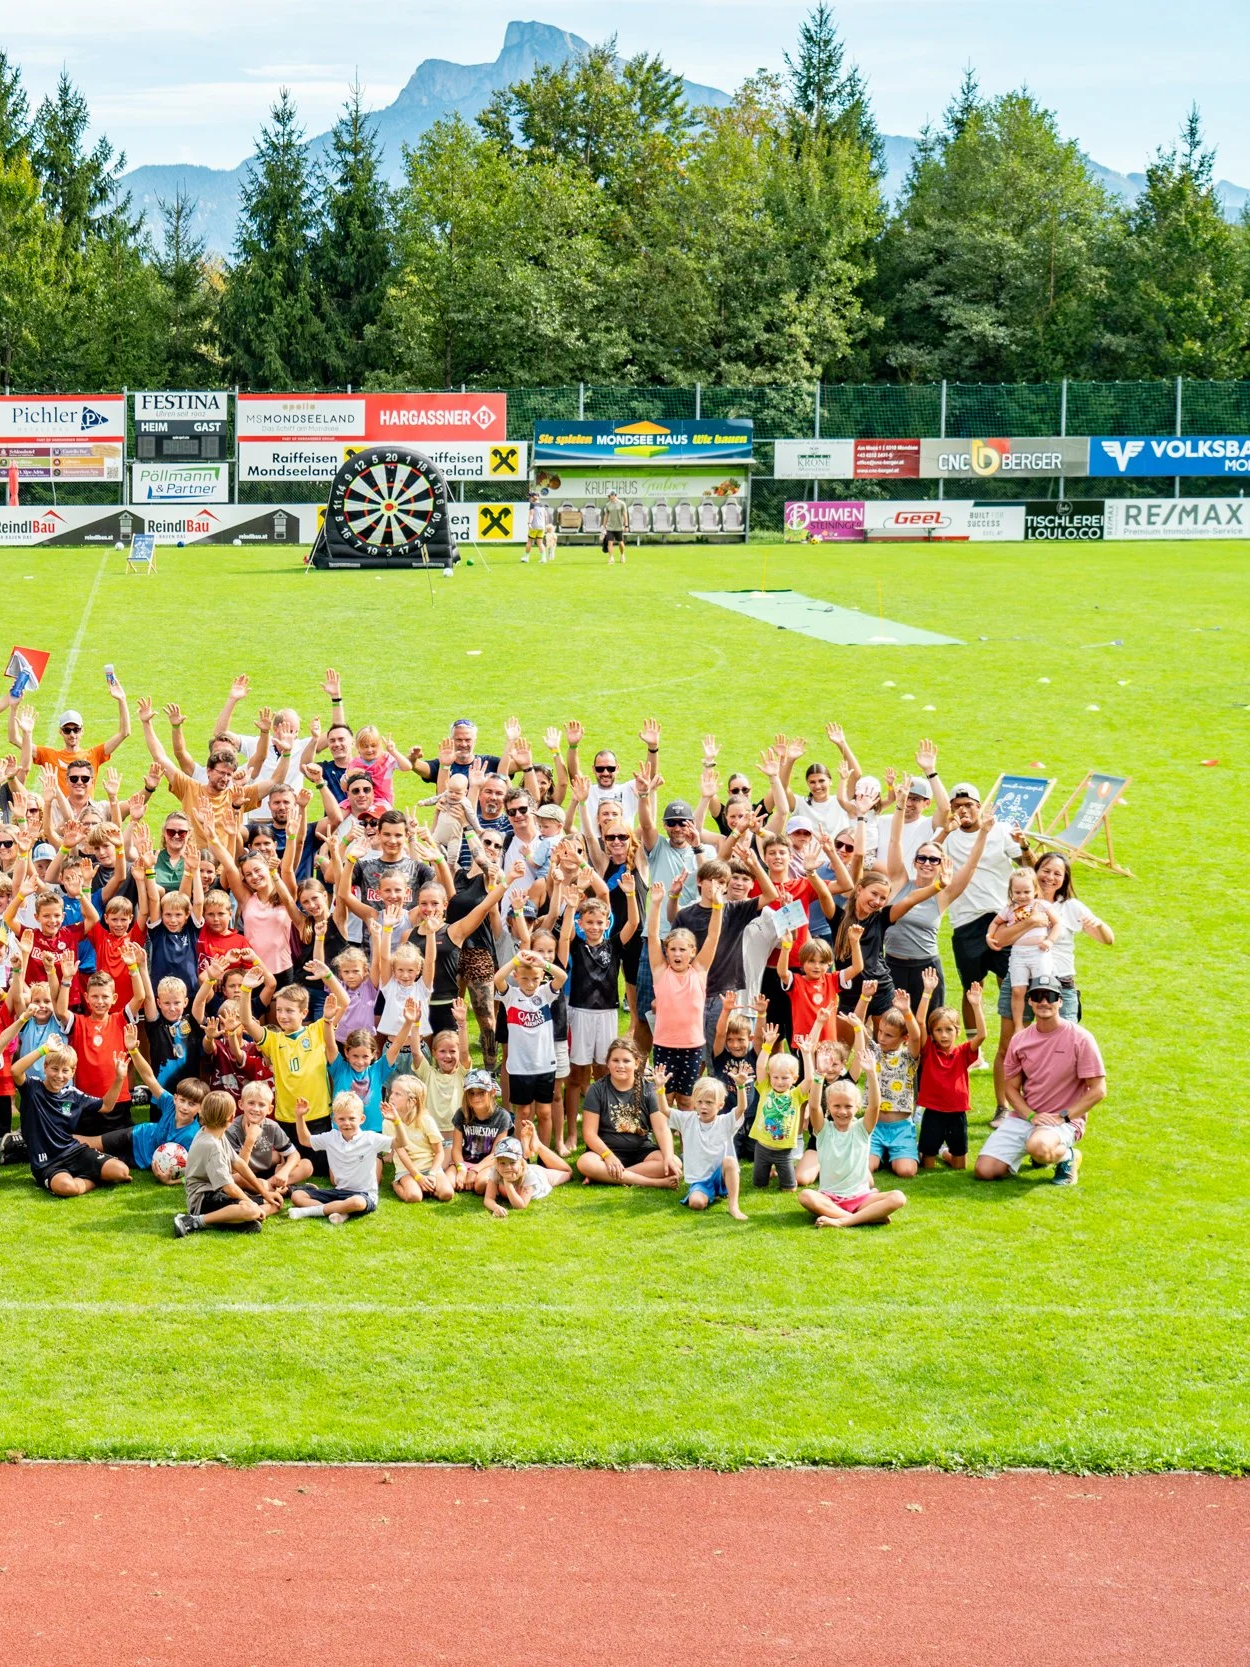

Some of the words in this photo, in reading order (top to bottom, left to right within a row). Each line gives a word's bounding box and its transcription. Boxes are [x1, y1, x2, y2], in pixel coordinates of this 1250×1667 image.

[142, 394, 220, 410] FESTINA
[13, 407, 78, 423] Pichler
[380, 410, 471, 426] HARGASSNER
[141, 422, 168, 432] HEIM
[193, 422, 221, 432] GAST
[538, 434, 554, 445] Sie
[555, 434, 593, 447] spielen
[597, 435, 653, 445] MONDSEE
[656, 434, 688, 445] HAUS
[714, 434, 748, 444] bauen
[272, 452, 338, 464] Raiffeisen
[371, 455, 379, 464] 5
[385, 453, 398, 462] 20
[405, 455, 411, 464] 1
[797, 458, 831, 467] KRONE
[938, 453, 970, 470] CNC
[1001, 453, 1062, 470] BERGER
[247, 465, 338, 476] Mondseeland
[354, 460, 367, 472] 12
[416, 460, 428, 472] 18
[141, 470, 212, 482] Pöllmann
[344, 473, 353, 481] 9
[156, 485, 164, 493] &
[166, 484, 217, 494] Partner
[336, 484, 346, 496] 14
[433, 482, 443, 494] 13
[585, 480, 638, 495] KAUFHAUS
[333, 499, 342, 509] 11
[431, 512, 442, 523] 10
[786, 502, 863, 531] BLUMEN
[894, 511, 944, 524] Geel
[1124, 503, 1243, 526] RE/MAX
[148, 519, 209, 533] ReindlBau
[811, 521, 862, 530] STEININGER
[1025, 515, 1103, 527] TISCHLEREI
[340, 527, 352, 539] 16
[423, 526, 435, 539] 15
[1028, 528, 1100, 540] LOULO.CO
[354, 540, 362, 548] 7
[398, 545, 409, 554] 17
[414, 539, 422, 548] 2
[366, 546, 378, 556] 19
[386, 548, 393, 556] 3
[518, 1010, 544, 1022] QATAR
[523, 1018, 545, 1028] AIRWAYS
[289, 1056, 300, 1072] 10
[463, 1125, 499, 1138] WEDNESDAY
[38, 1152, 48, 1162] LH
